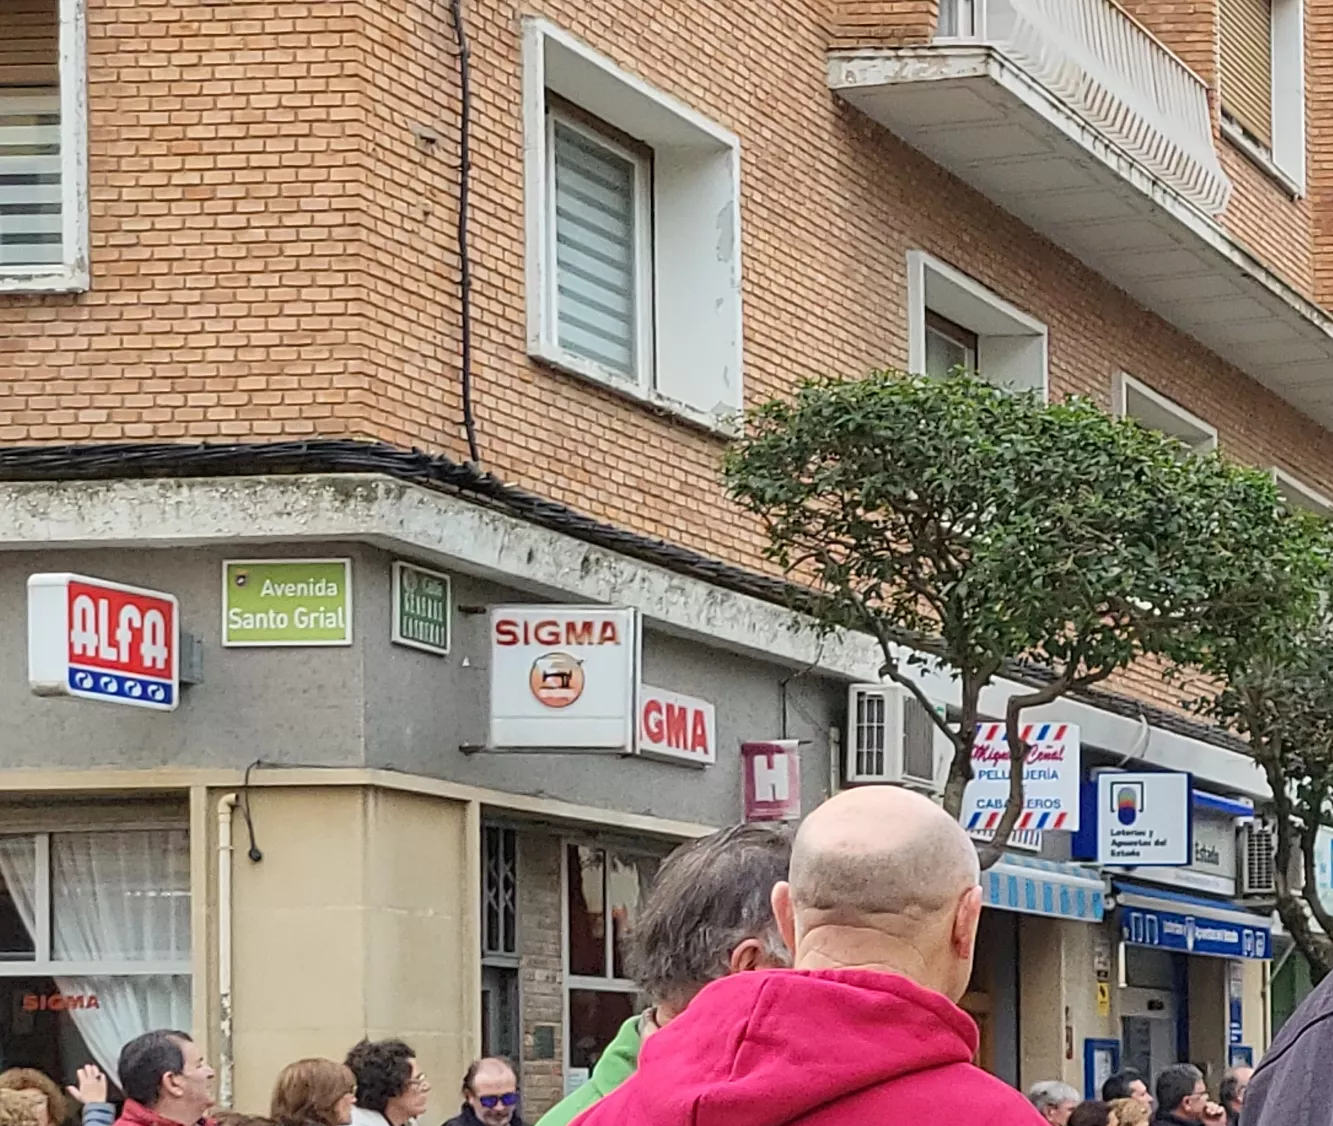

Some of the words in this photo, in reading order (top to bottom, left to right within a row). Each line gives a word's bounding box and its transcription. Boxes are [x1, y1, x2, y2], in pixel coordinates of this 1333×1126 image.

[260, 578, 338, 597] Avenida
[228, 607, 289, 630] Santo
[294, 605, 346, 630] Grial
[71, 594, 168, 669] ALFA
[495, 619, 621, 646] SIGMA
[640, 698, 709, 755] GMA
[22, 994, 100, 1011] SIGMA
